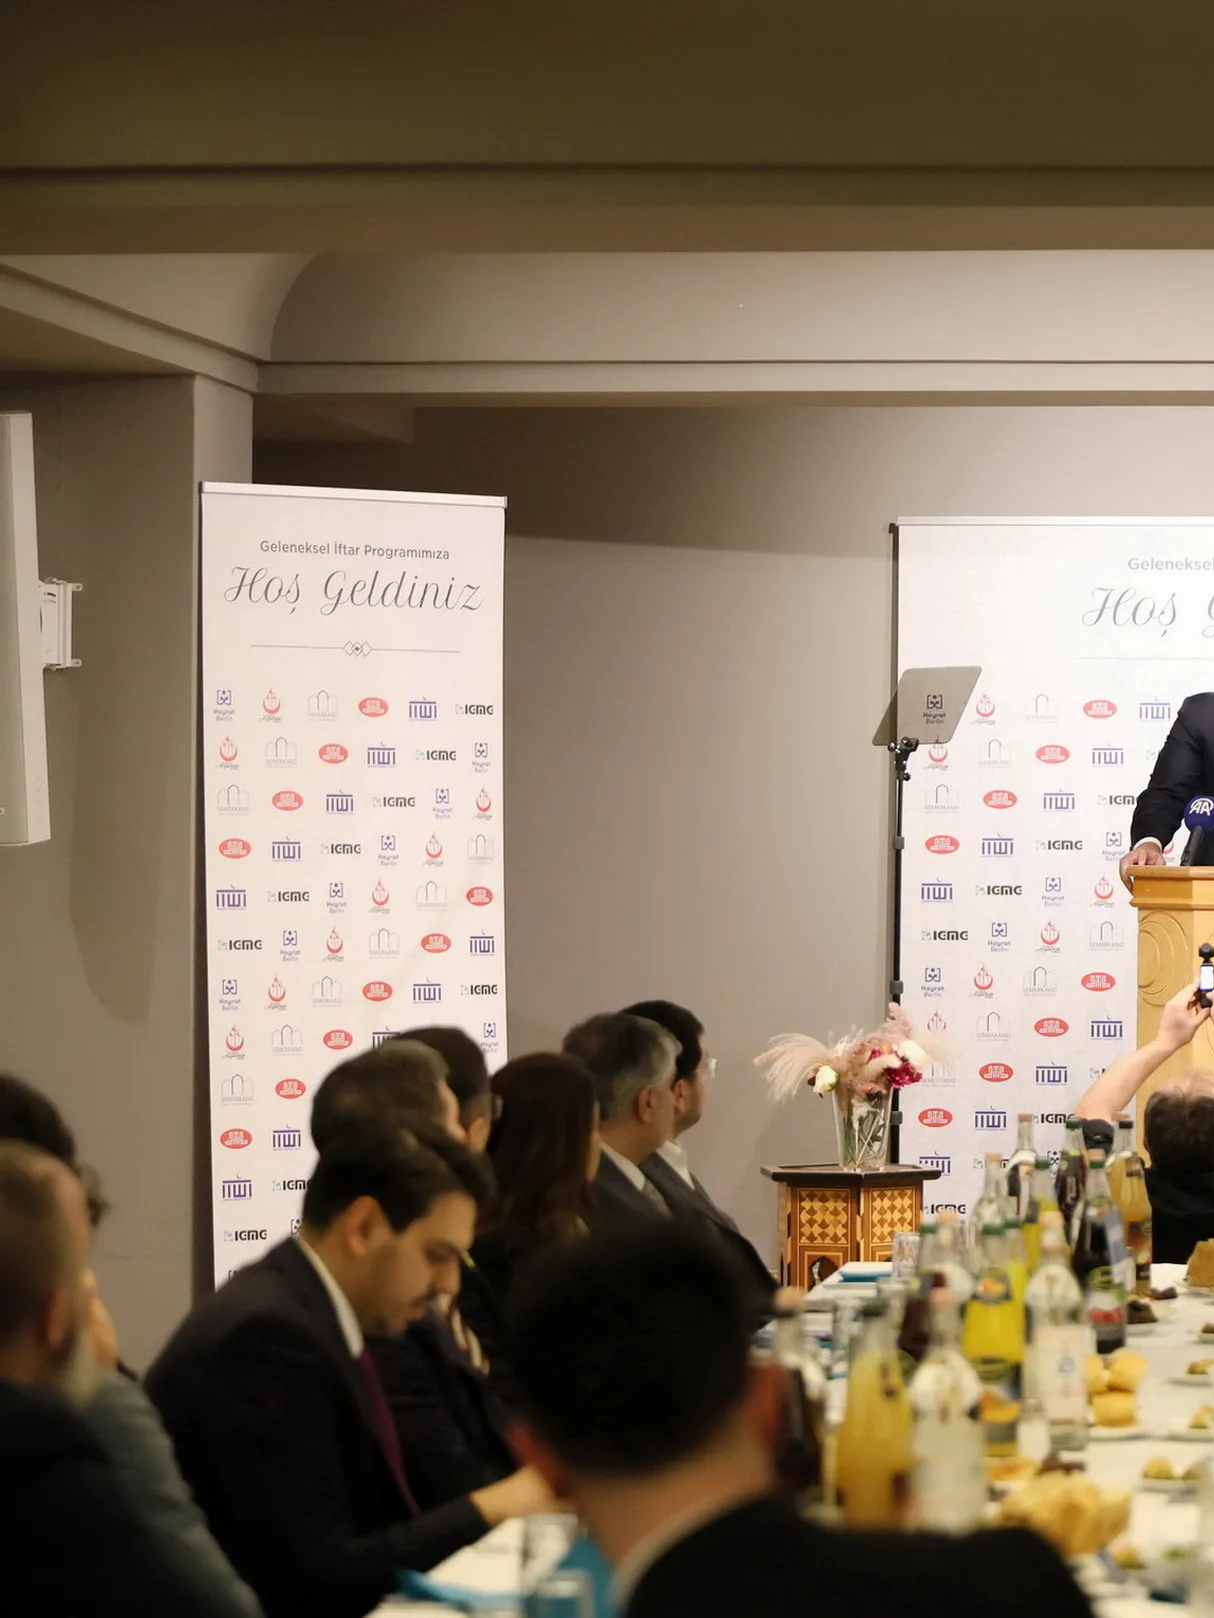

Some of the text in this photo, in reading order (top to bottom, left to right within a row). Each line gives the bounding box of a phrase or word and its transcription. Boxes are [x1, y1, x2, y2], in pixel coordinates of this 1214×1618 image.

[260, 541, 449, 560] Geleneksel İftar Programımıza
[224, 567, 484, 616] Hoş Geldiniz
[1081, 588, 1176, 638] Hoş
[1110, 795, 1138, 805] IGM
[1189, 798, 1214, 816] AA
[1041, 1114, 1075, 1123] IGM
[283, 1180, 310, 1190] IGM
